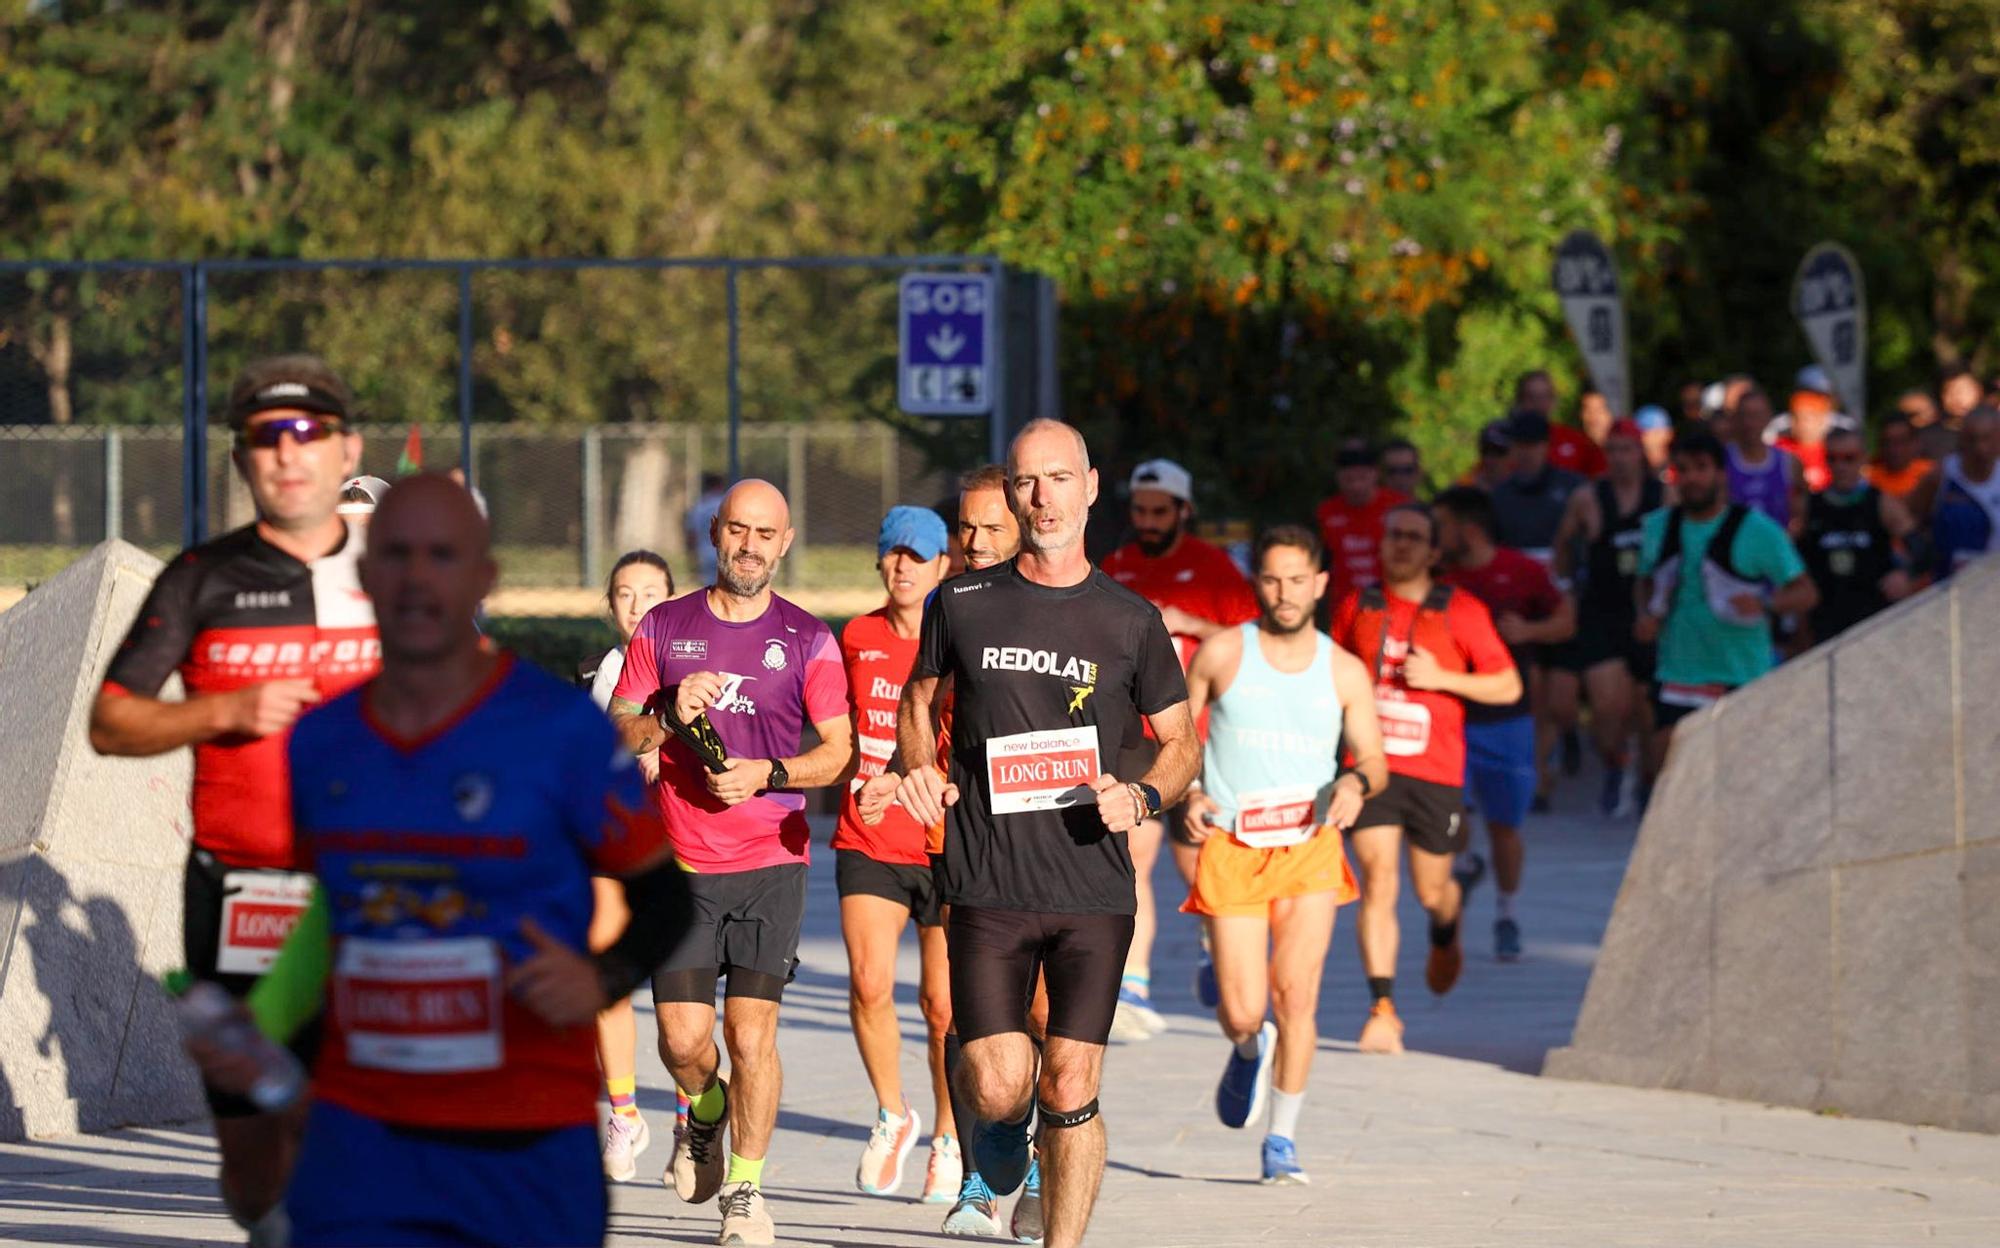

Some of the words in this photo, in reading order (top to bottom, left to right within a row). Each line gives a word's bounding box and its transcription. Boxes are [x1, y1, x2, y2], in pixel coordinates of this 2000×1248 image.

[907, 284, 985, 315] SOS
[953, 582, 983, 594] luanvi
[981, 647, 1090, 683] REDOLAT
[1088, 662, 1099, 685] TEAM
[1003, 742, 1028, 752] new
[1000, 762, 1047, 784] LONG
[1052, 758, 1090, 780] RUN
